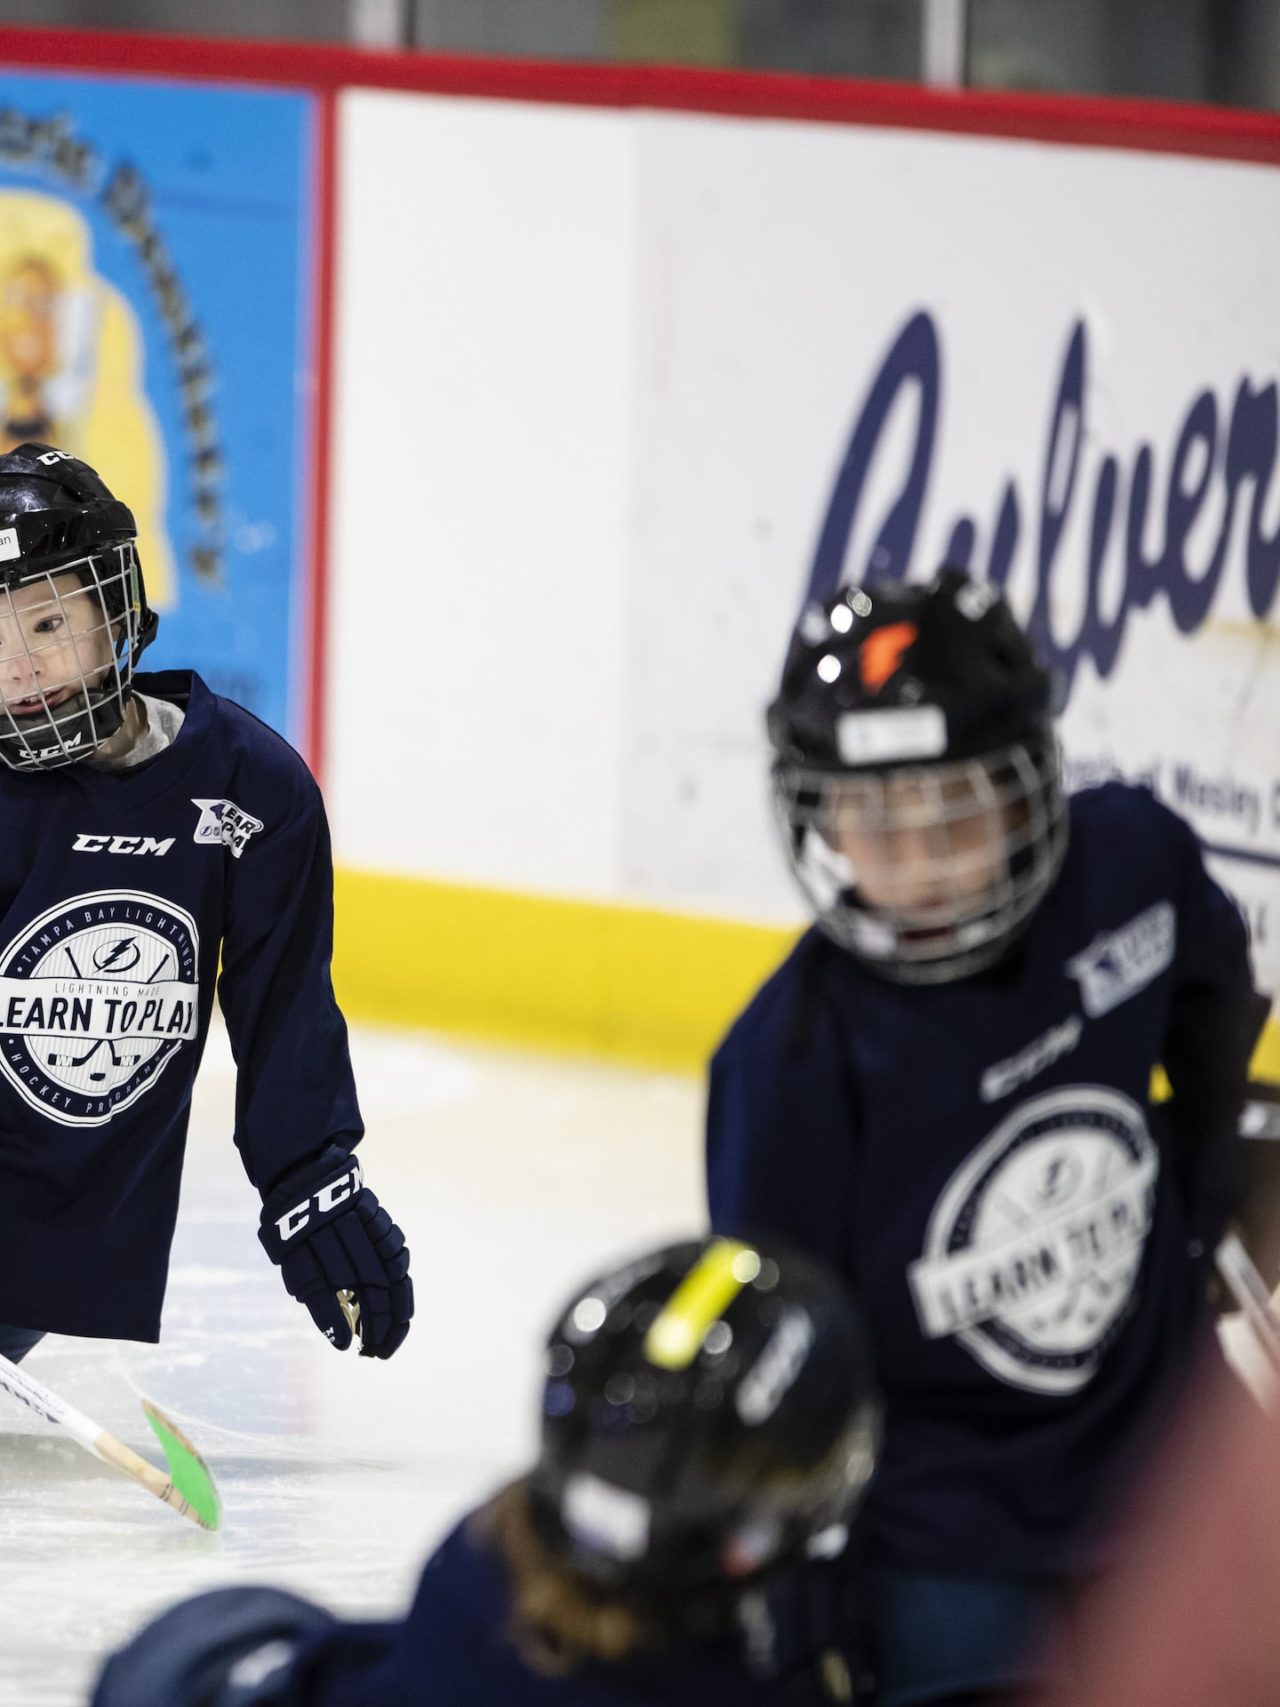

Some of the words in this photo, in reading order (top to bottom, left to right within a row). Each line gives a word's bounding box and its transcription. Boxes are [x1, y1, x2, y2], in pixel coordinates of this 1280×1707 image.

[72, 833, 177, 857] CCM
[22, 919, 74, 964] TAMPA
[84, 907, 116, 923] BAY
[125, 907, 193, 967] LIGHTNING
[55, 983, 129, 997] LIGHTNING
[104, 999, 138, 1034] TO
[11, 1052, 72, 1110] HOCKEY
